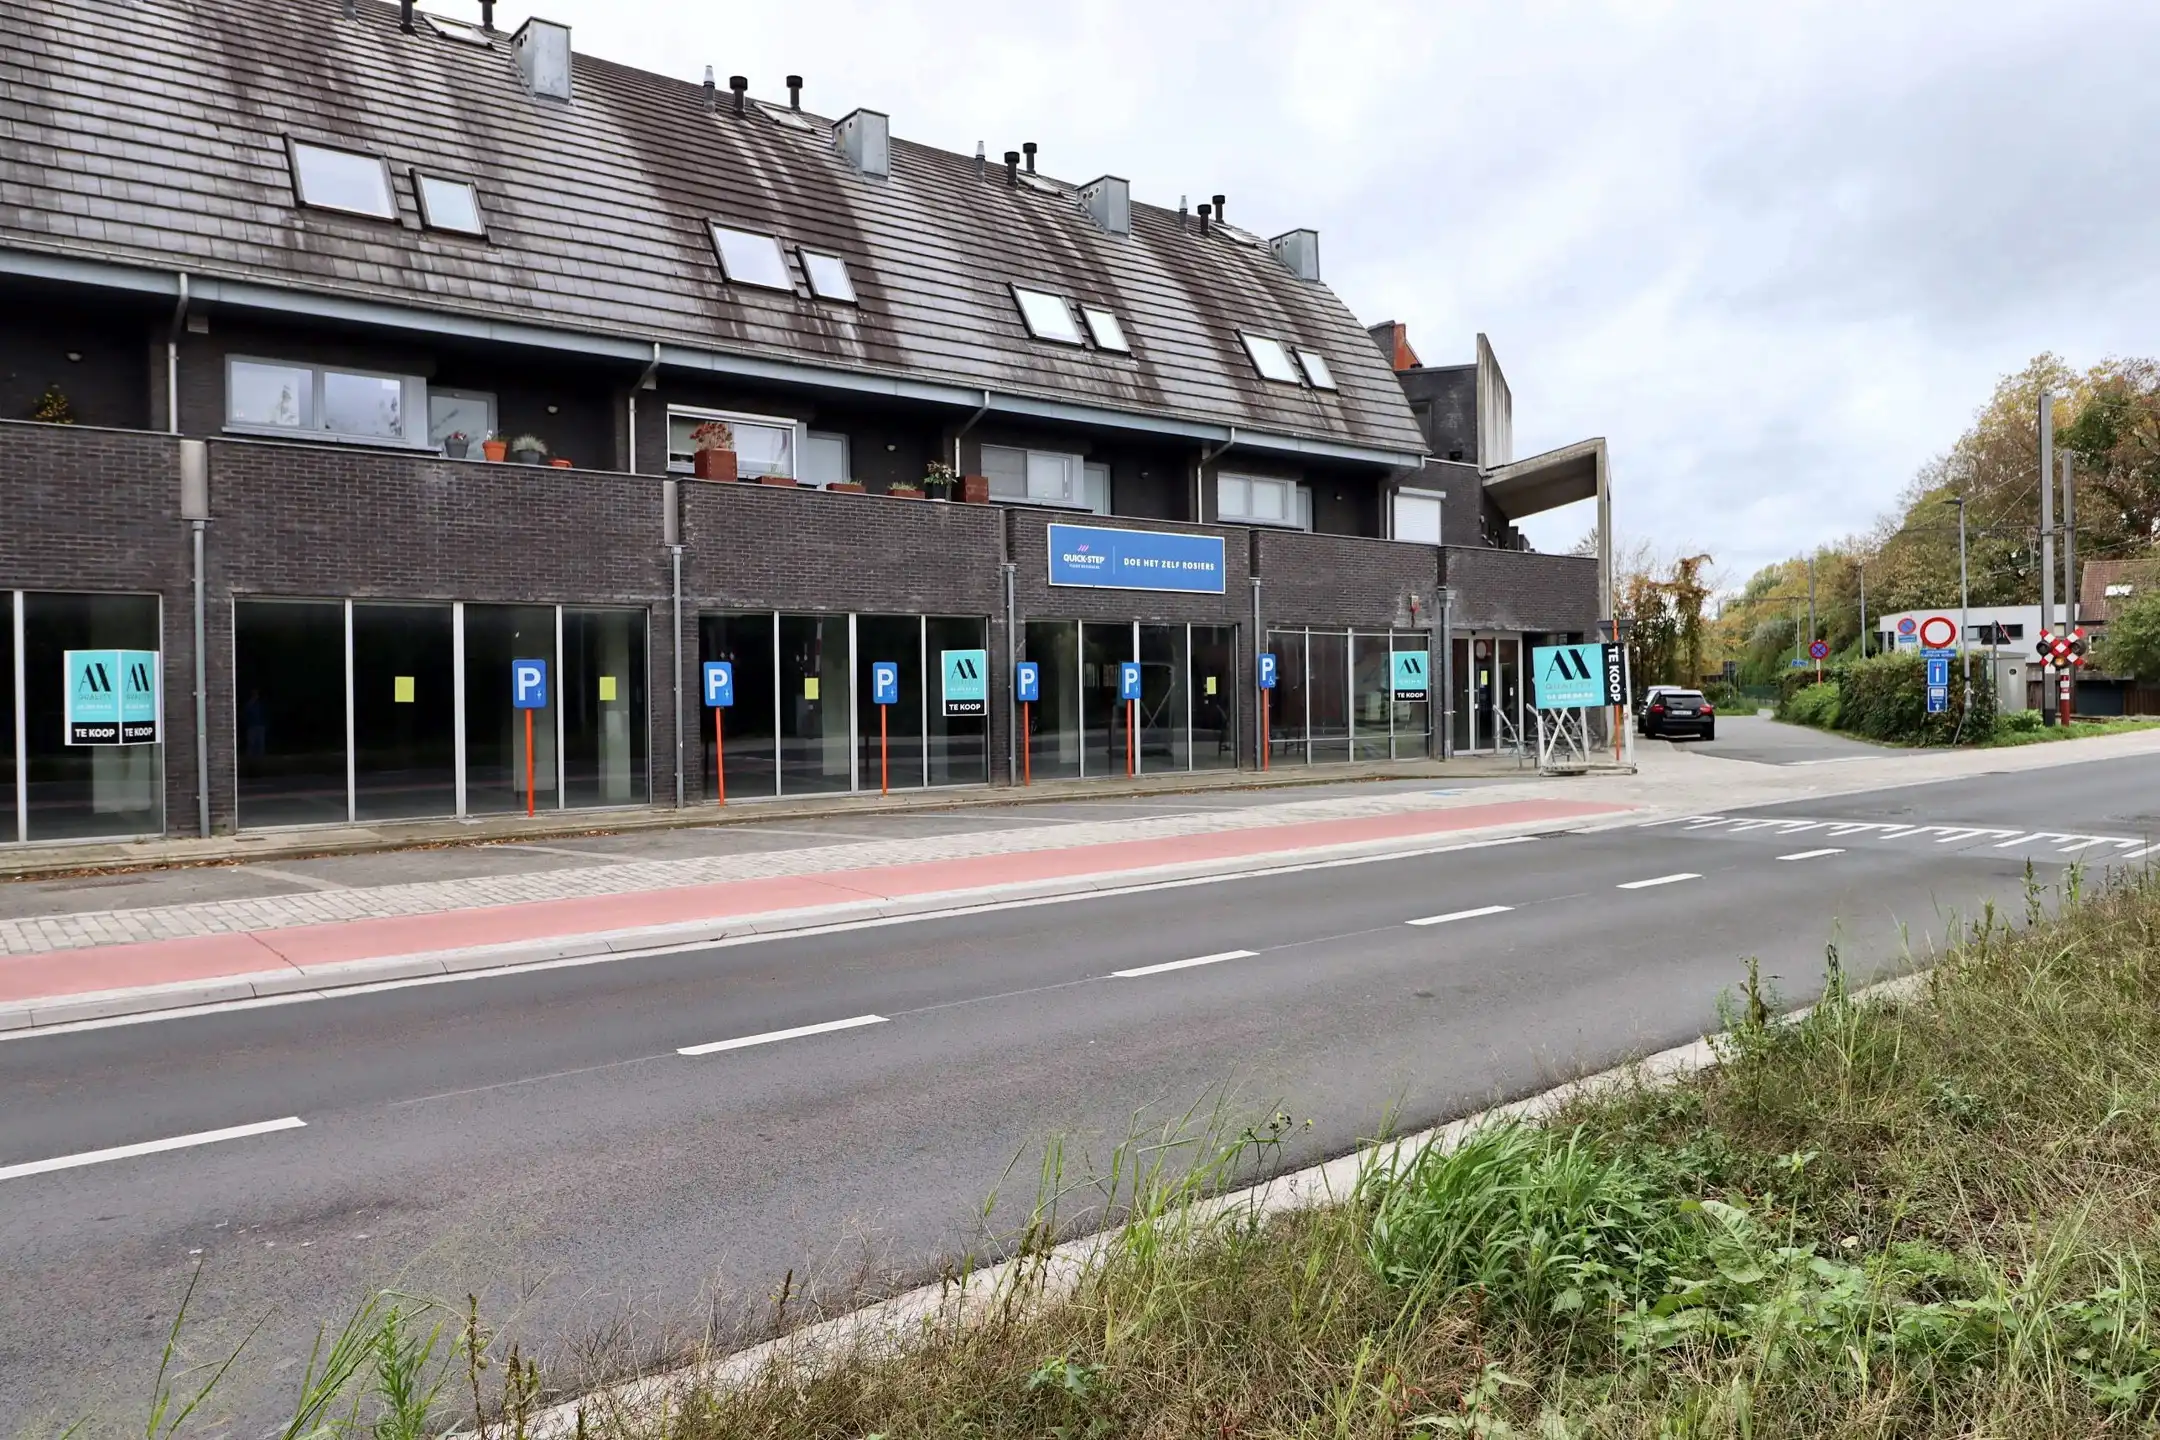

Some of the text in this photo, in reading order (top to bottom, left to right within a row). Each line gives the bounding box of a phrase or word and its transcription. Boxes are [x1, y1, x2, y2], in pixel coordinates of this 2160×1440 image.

[1123, 558, 1215, 571] DOE HET ZELF ROSIERS
[877, 668, 894, 697] P
[1020, 668, 1035, 695] P
[1124, 668, 1138, 695] P
[1262, 657, 1274, 681] P
[1607, 646, 1621, 702] TE KOOP
[517, 667, 541, 701] P
[708, 668, 729, 700] P
[949, 703, 981, 711] TE KOOP
[75, 728, 115, 738] TE KOOP
[124, 727, 153, 737] TE KOOP
